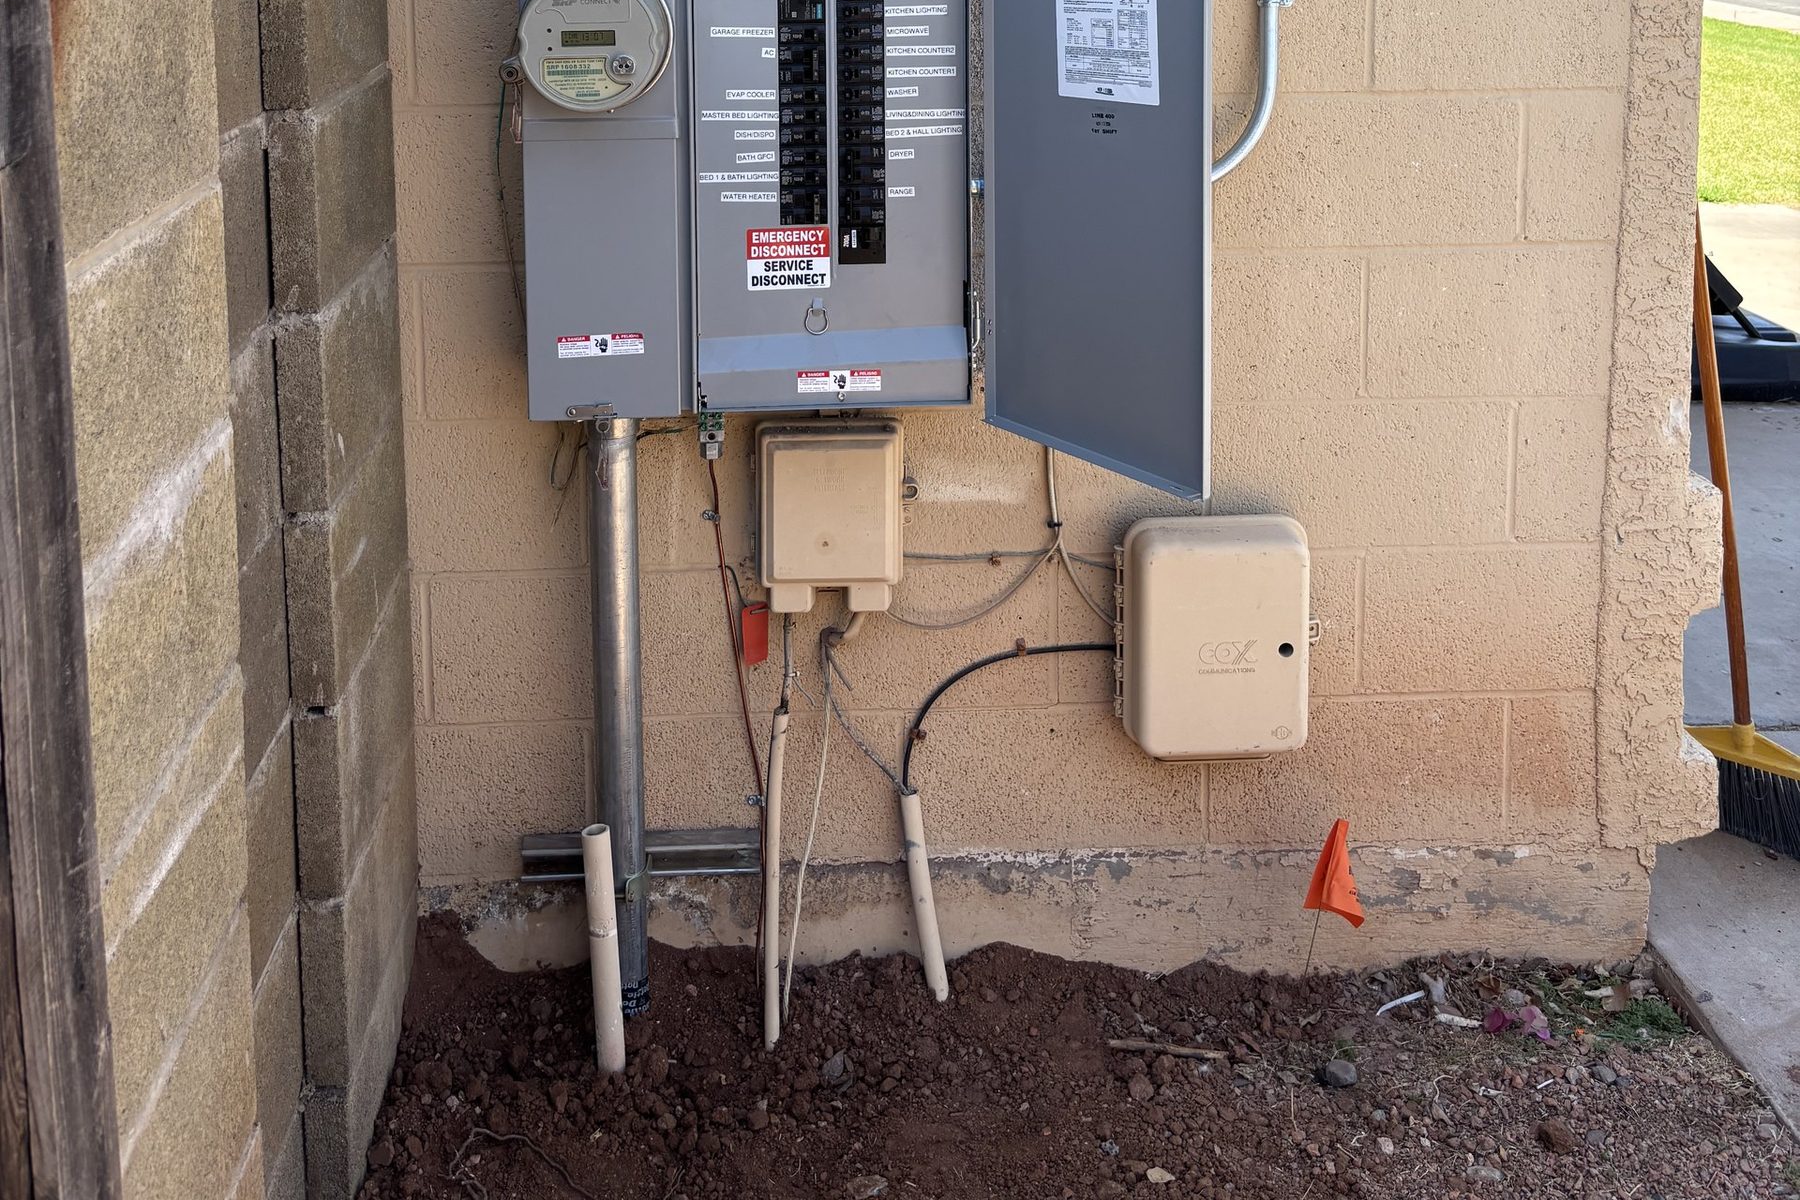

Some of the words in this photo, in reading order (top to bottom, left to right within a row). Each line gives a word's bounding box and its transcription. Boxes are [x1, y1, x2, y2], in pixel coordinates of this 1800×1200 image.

[752, 230, 824, 243] EMERGENCY
[751, 244, 826, 258] DISCONNECT
[764, 260, 814, 272] SERVICE
[752, 274, 826, 286] DISCONNECT
[1199, 640, 1258, 665] COX
